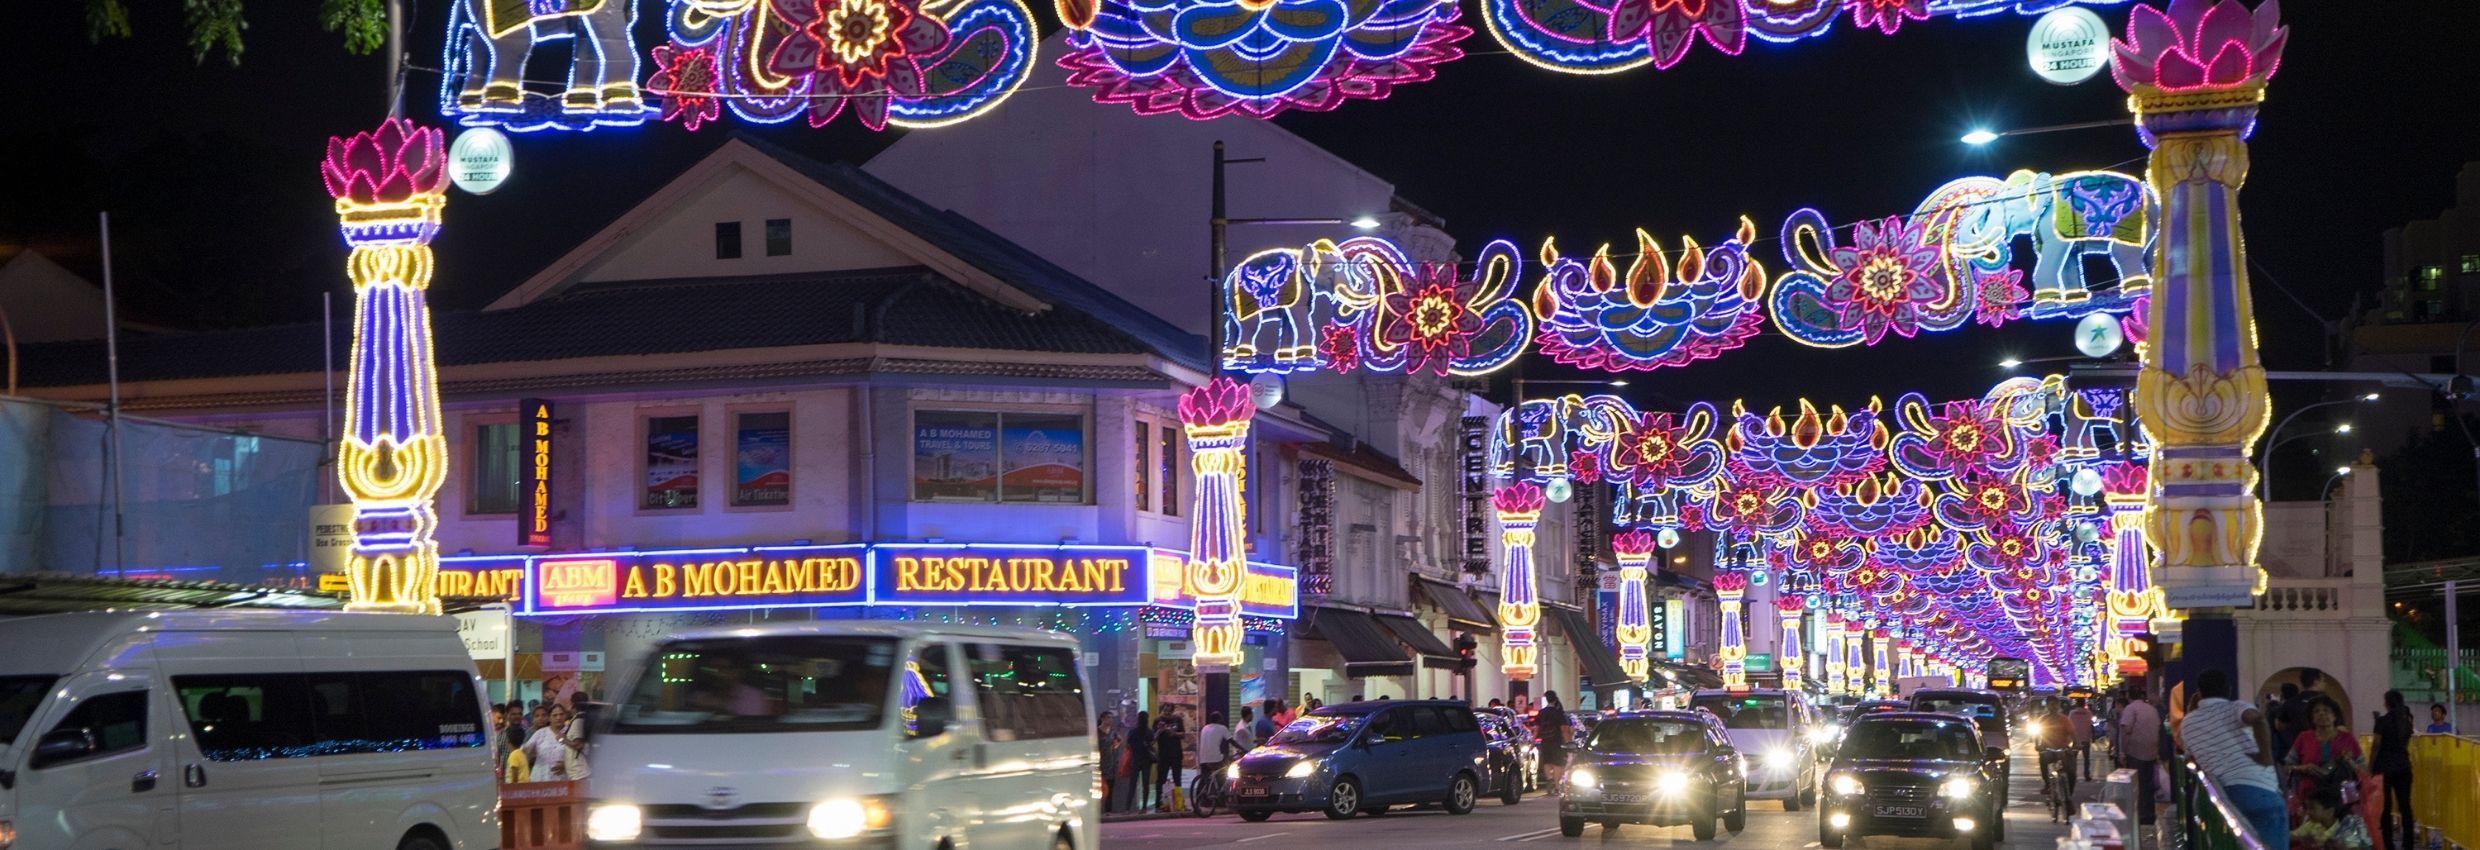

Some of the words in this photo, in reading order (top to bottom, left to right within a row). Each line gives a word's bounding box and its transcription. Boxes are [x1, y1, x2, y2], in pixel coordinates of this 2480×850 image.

[2042, 39, 2095, 50] MUSTAFA
[920, 429, 927, 438] A
[930, 429, 937, 438] B
[939, 429, 992, 439] MOHAMED
[920, 440, 953, 449] TRAVEL
[963, 440, 992, 450] TOURS
[535, 439, 549, 533] MOHAMED
[1466, 435, 1484, 554] CENTRE
[436, 568, 525, 602] URANT
[545, 565, 607, 590] ABM
[622, 565, 648, 598] A
[652, 563, 677, 598] B
[682, 557, 862, 597] MOHAMED
[896, 557, 1129, 593] RESTAURANT
[465, 637, 498, 651] School
[1876, 806, 1924, 816] SJP5130Y
